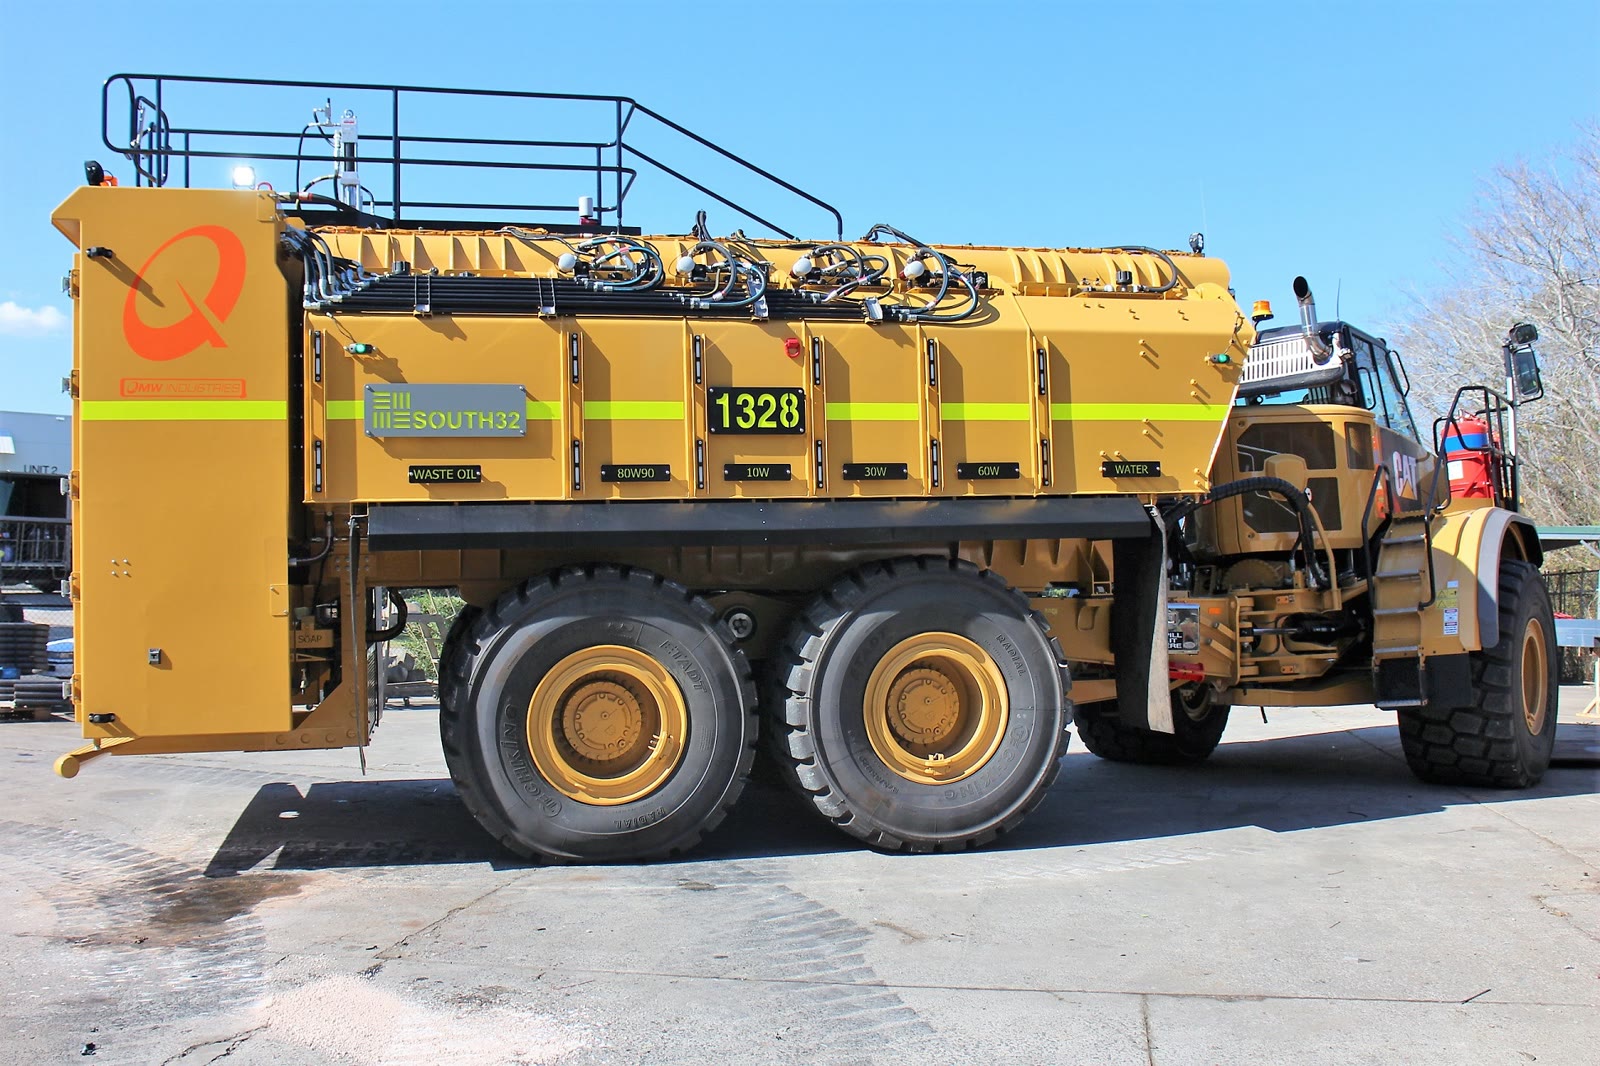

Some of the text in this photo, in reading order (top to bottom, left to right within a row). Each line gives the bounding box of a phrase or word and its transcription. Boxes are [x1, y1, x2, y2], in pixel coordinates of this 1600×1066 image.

[127, 382, 240, 394] QMW INDUSTRIES
[716, 393, 799, 429] 1328
[413, 411, 520, 430] SOUTH32
[23, 464, 58, 474] UNIT 2
[413, 469, 477, 480] WASTE OIL
[617, 468, 655, 478] 80W90
[747, 467, 769, 478] 10W
[864, 466, 887, 477] 30W
[977, 466, 1000, 476] 60W
[1114, 464, 1149, 474] WATER
[1392, 451, 1418, 500] CAT
[298, 635, 322, 643] SOAP
[995, 634, 1026, 676] RADIAL
[613, 806, 666, 829] RADIAL
